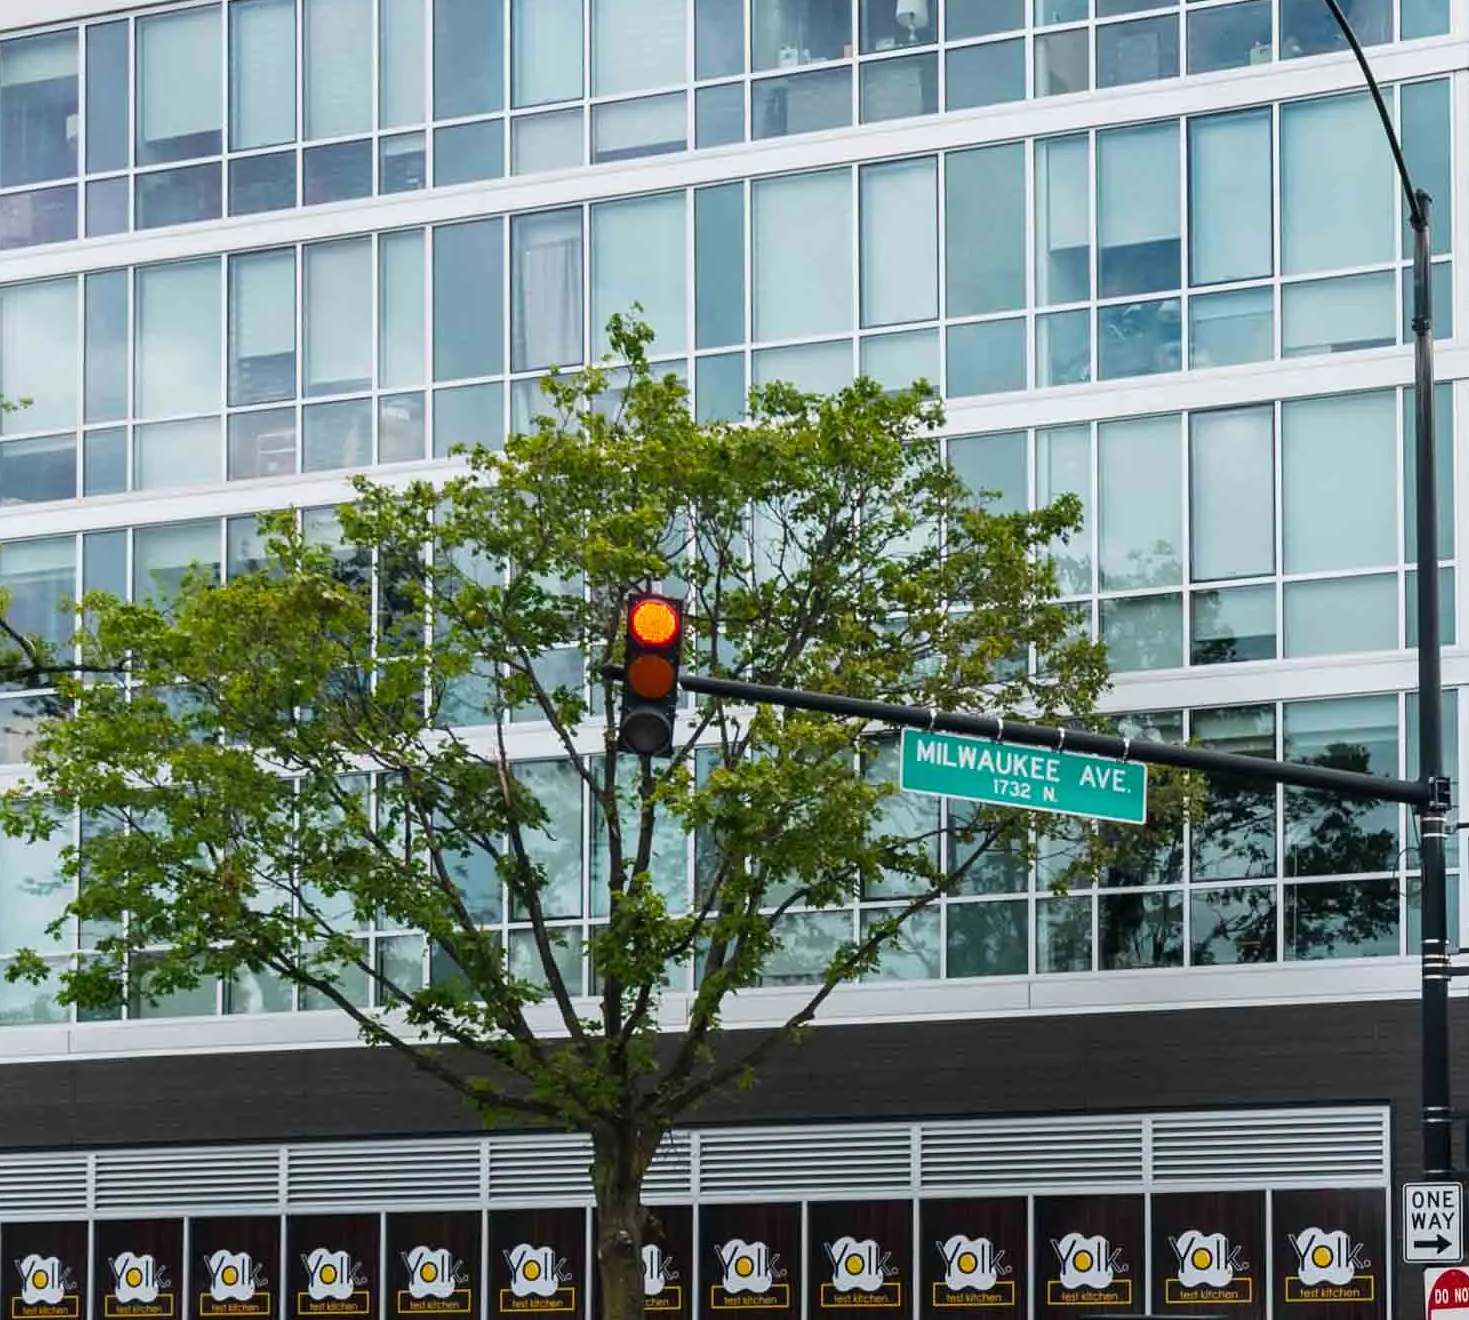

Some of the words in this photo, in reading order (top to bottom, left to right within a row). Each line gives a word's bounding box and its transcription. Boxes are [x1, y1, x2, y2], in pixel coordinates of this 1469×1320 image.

[916, 739, 1060, 782] MILWAUKEE
[1079, 765, 1132, 794] AVE.
[993, 779, 1031, 799] 1732
[1412, 1191, 1455, 1209] ONE
[1412, 1212, 1455, 1230] WAY
[643, 1248, 680, 1281] lk.
[1082, 1291, 1118, 1301] kitchen
[1201, 1288, 1238, 1299] kitchen
[1300, 1288, 1319, 1298] test
[1321, 1287, 1360, 1298] kitchen
[1435, 1288, 1448, 1304] DO
